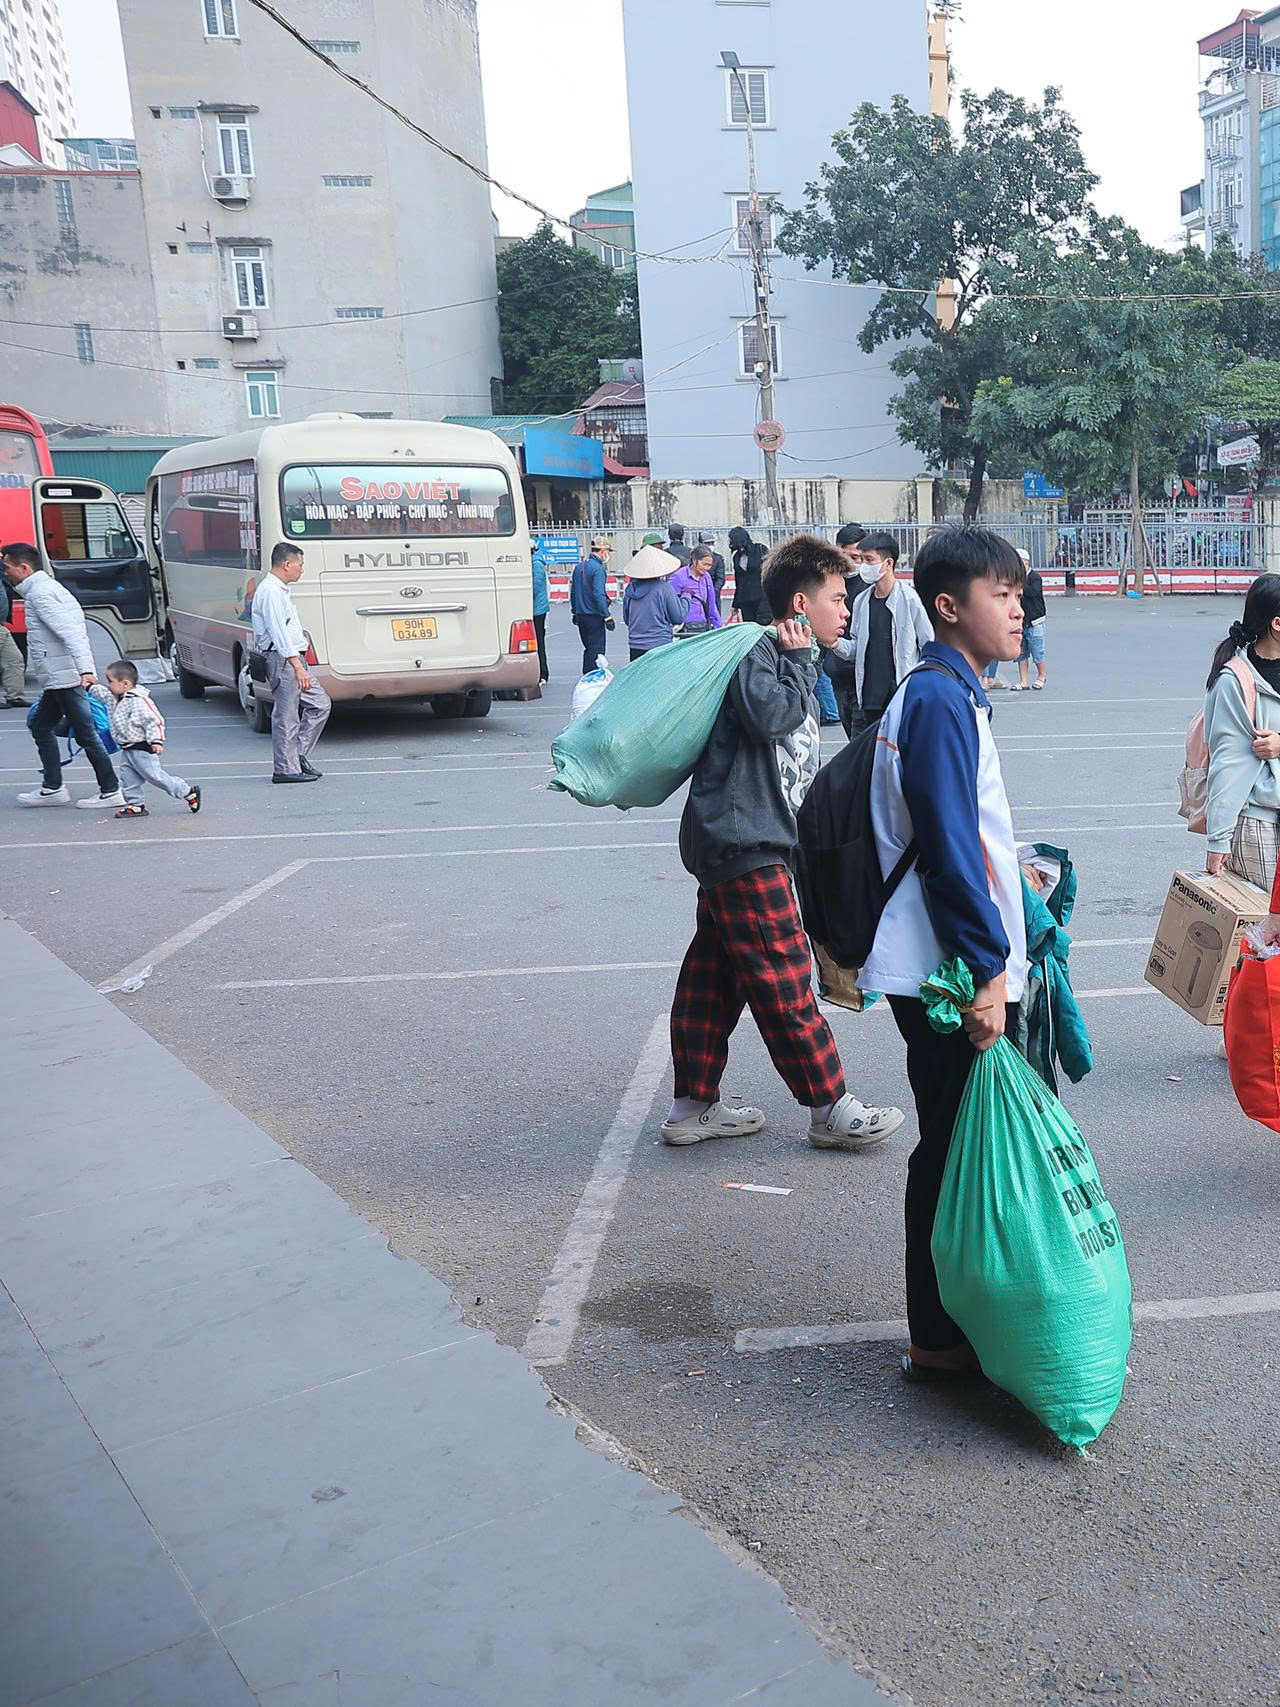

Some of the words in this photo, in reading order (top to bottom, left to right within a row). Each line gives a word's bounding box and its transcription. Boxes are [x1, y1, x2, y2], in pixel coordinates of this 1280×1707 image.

[1029, 480, 1035, 489] 4
[305, 502, 326, 520] HÒA
[327, 504, 348, 522] MẠC
[377, 501, 400, 519] PHÚC
[408, 503, 426, 522] CHỢ
[428, 504, 448, 522] MẠC
[344, 551, 469, 568] HYUNDAI
[405, 620, 424, 629] 90H
[398, 630, 433, 640] 034.89
[1173, 877, 1217, 915] Panasonic
